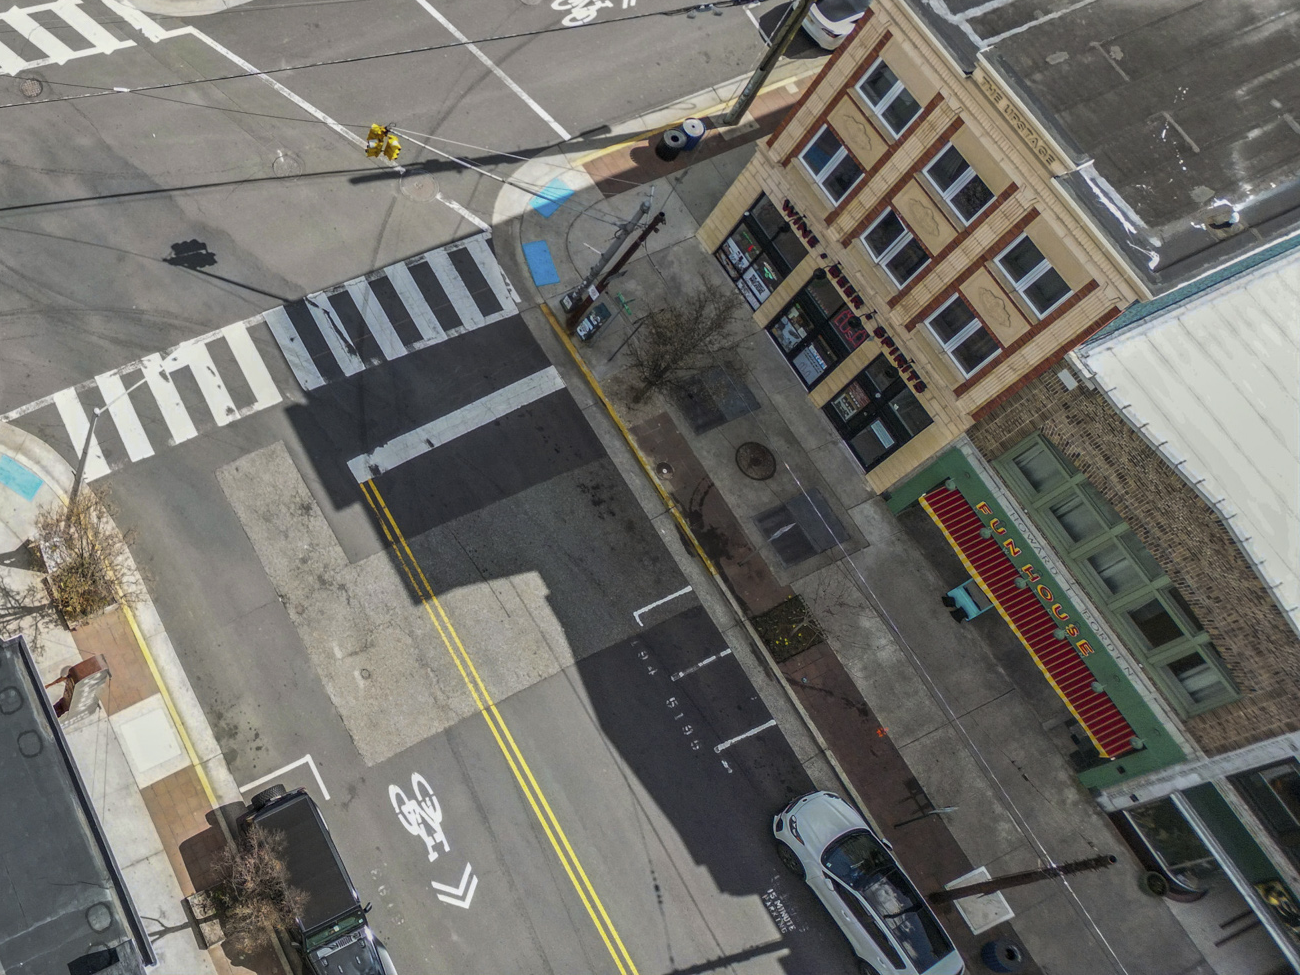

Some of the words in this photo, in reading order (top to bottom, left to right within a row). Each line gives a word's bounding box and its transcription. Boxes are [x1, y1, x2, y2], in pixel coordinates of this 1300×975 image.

[981, 76, 1003, 104] THE
[1004, 103, 1055, 165] UPSTAGE
[782, 199, 819, 249] WINE
[828, 265, 864, 310] BEER
[873, 326, 928, 394] SPIRITS
[976, 501, 1023, 557] FUN
[1022, 563, 1095, 657] HOUSE
[1010, 512, 1060, 576] HOWARD
[1082, 610, 1134, 677] BORDEN
[762, 895, 788, 933] PARKING
[767, 889, 777, 900] 15
[775, 900, 797, 932] MINUTE
